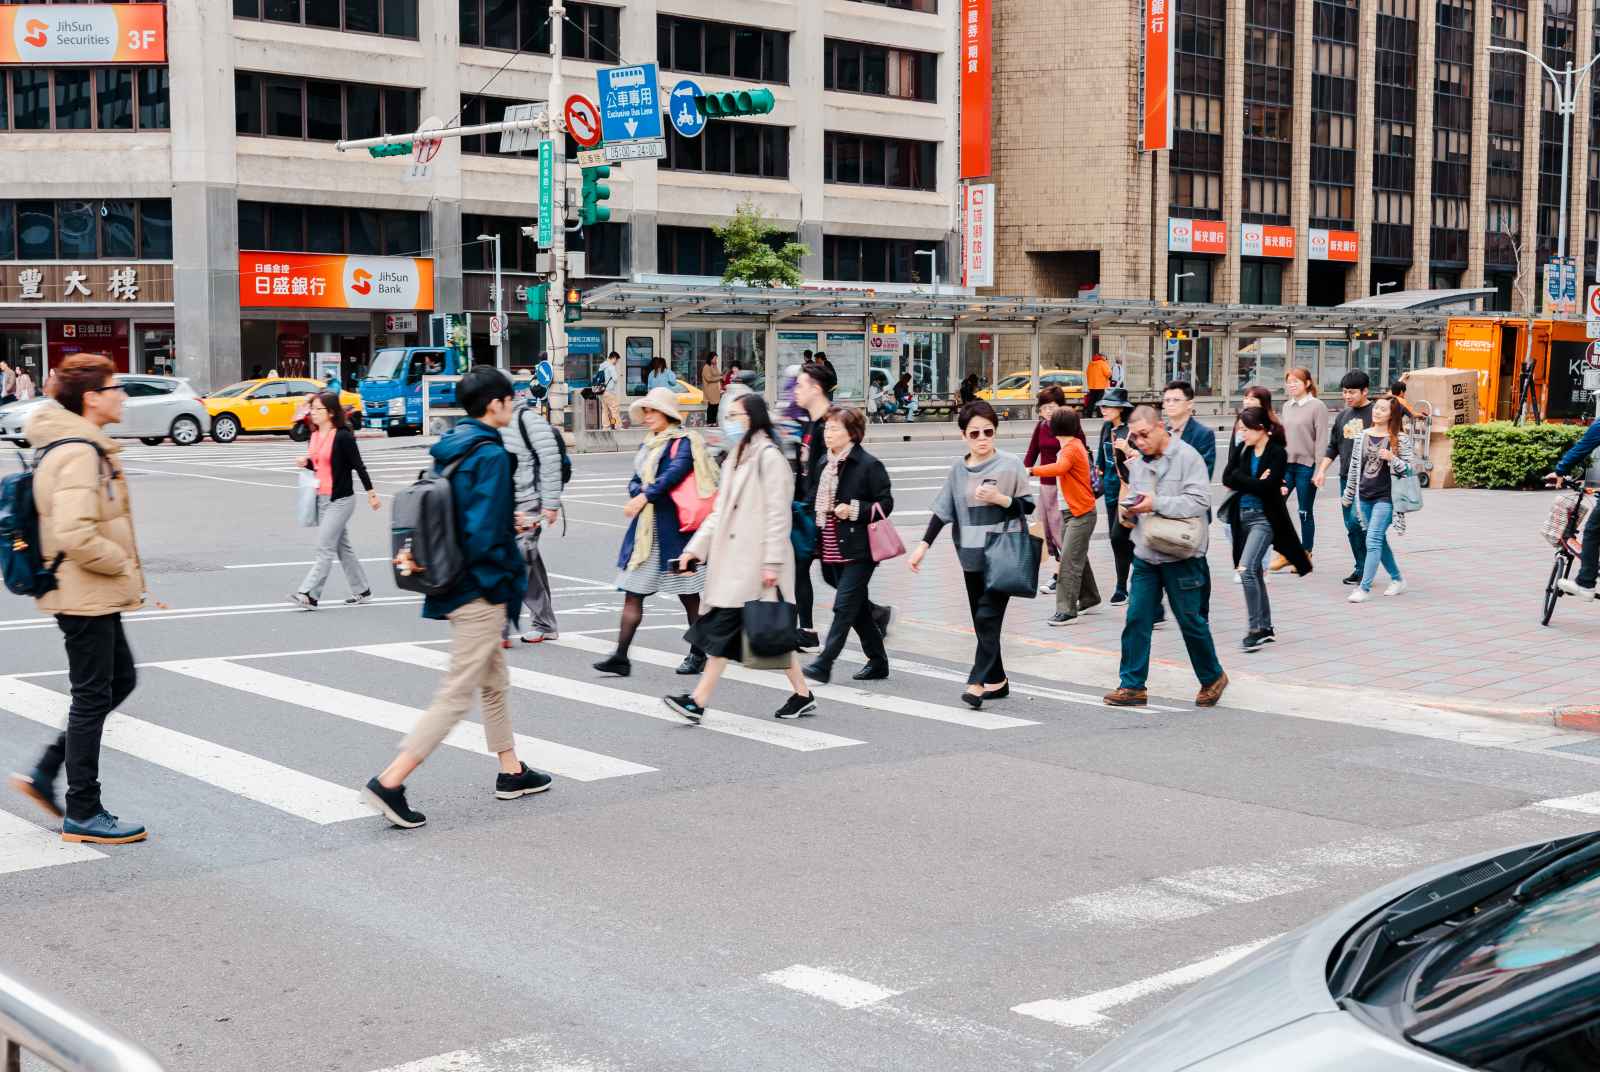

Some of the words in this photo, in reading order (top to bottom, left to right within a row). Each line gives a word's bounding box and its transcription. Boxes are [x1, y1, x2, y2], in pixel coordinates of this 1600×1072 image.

[56, 21, 93, 32] JihSun
[56, 34, 110, 46] Securities
[128, 30, 157, 50] 3F
[606, 87, 652, 108] 公車專用
[607, 109, 630, 119] Exclusive
[378, 272, 409, 282] JihSun
[255, 276, 326, 296] 日盛銀行
[378, 284, 401, 294] Bank
